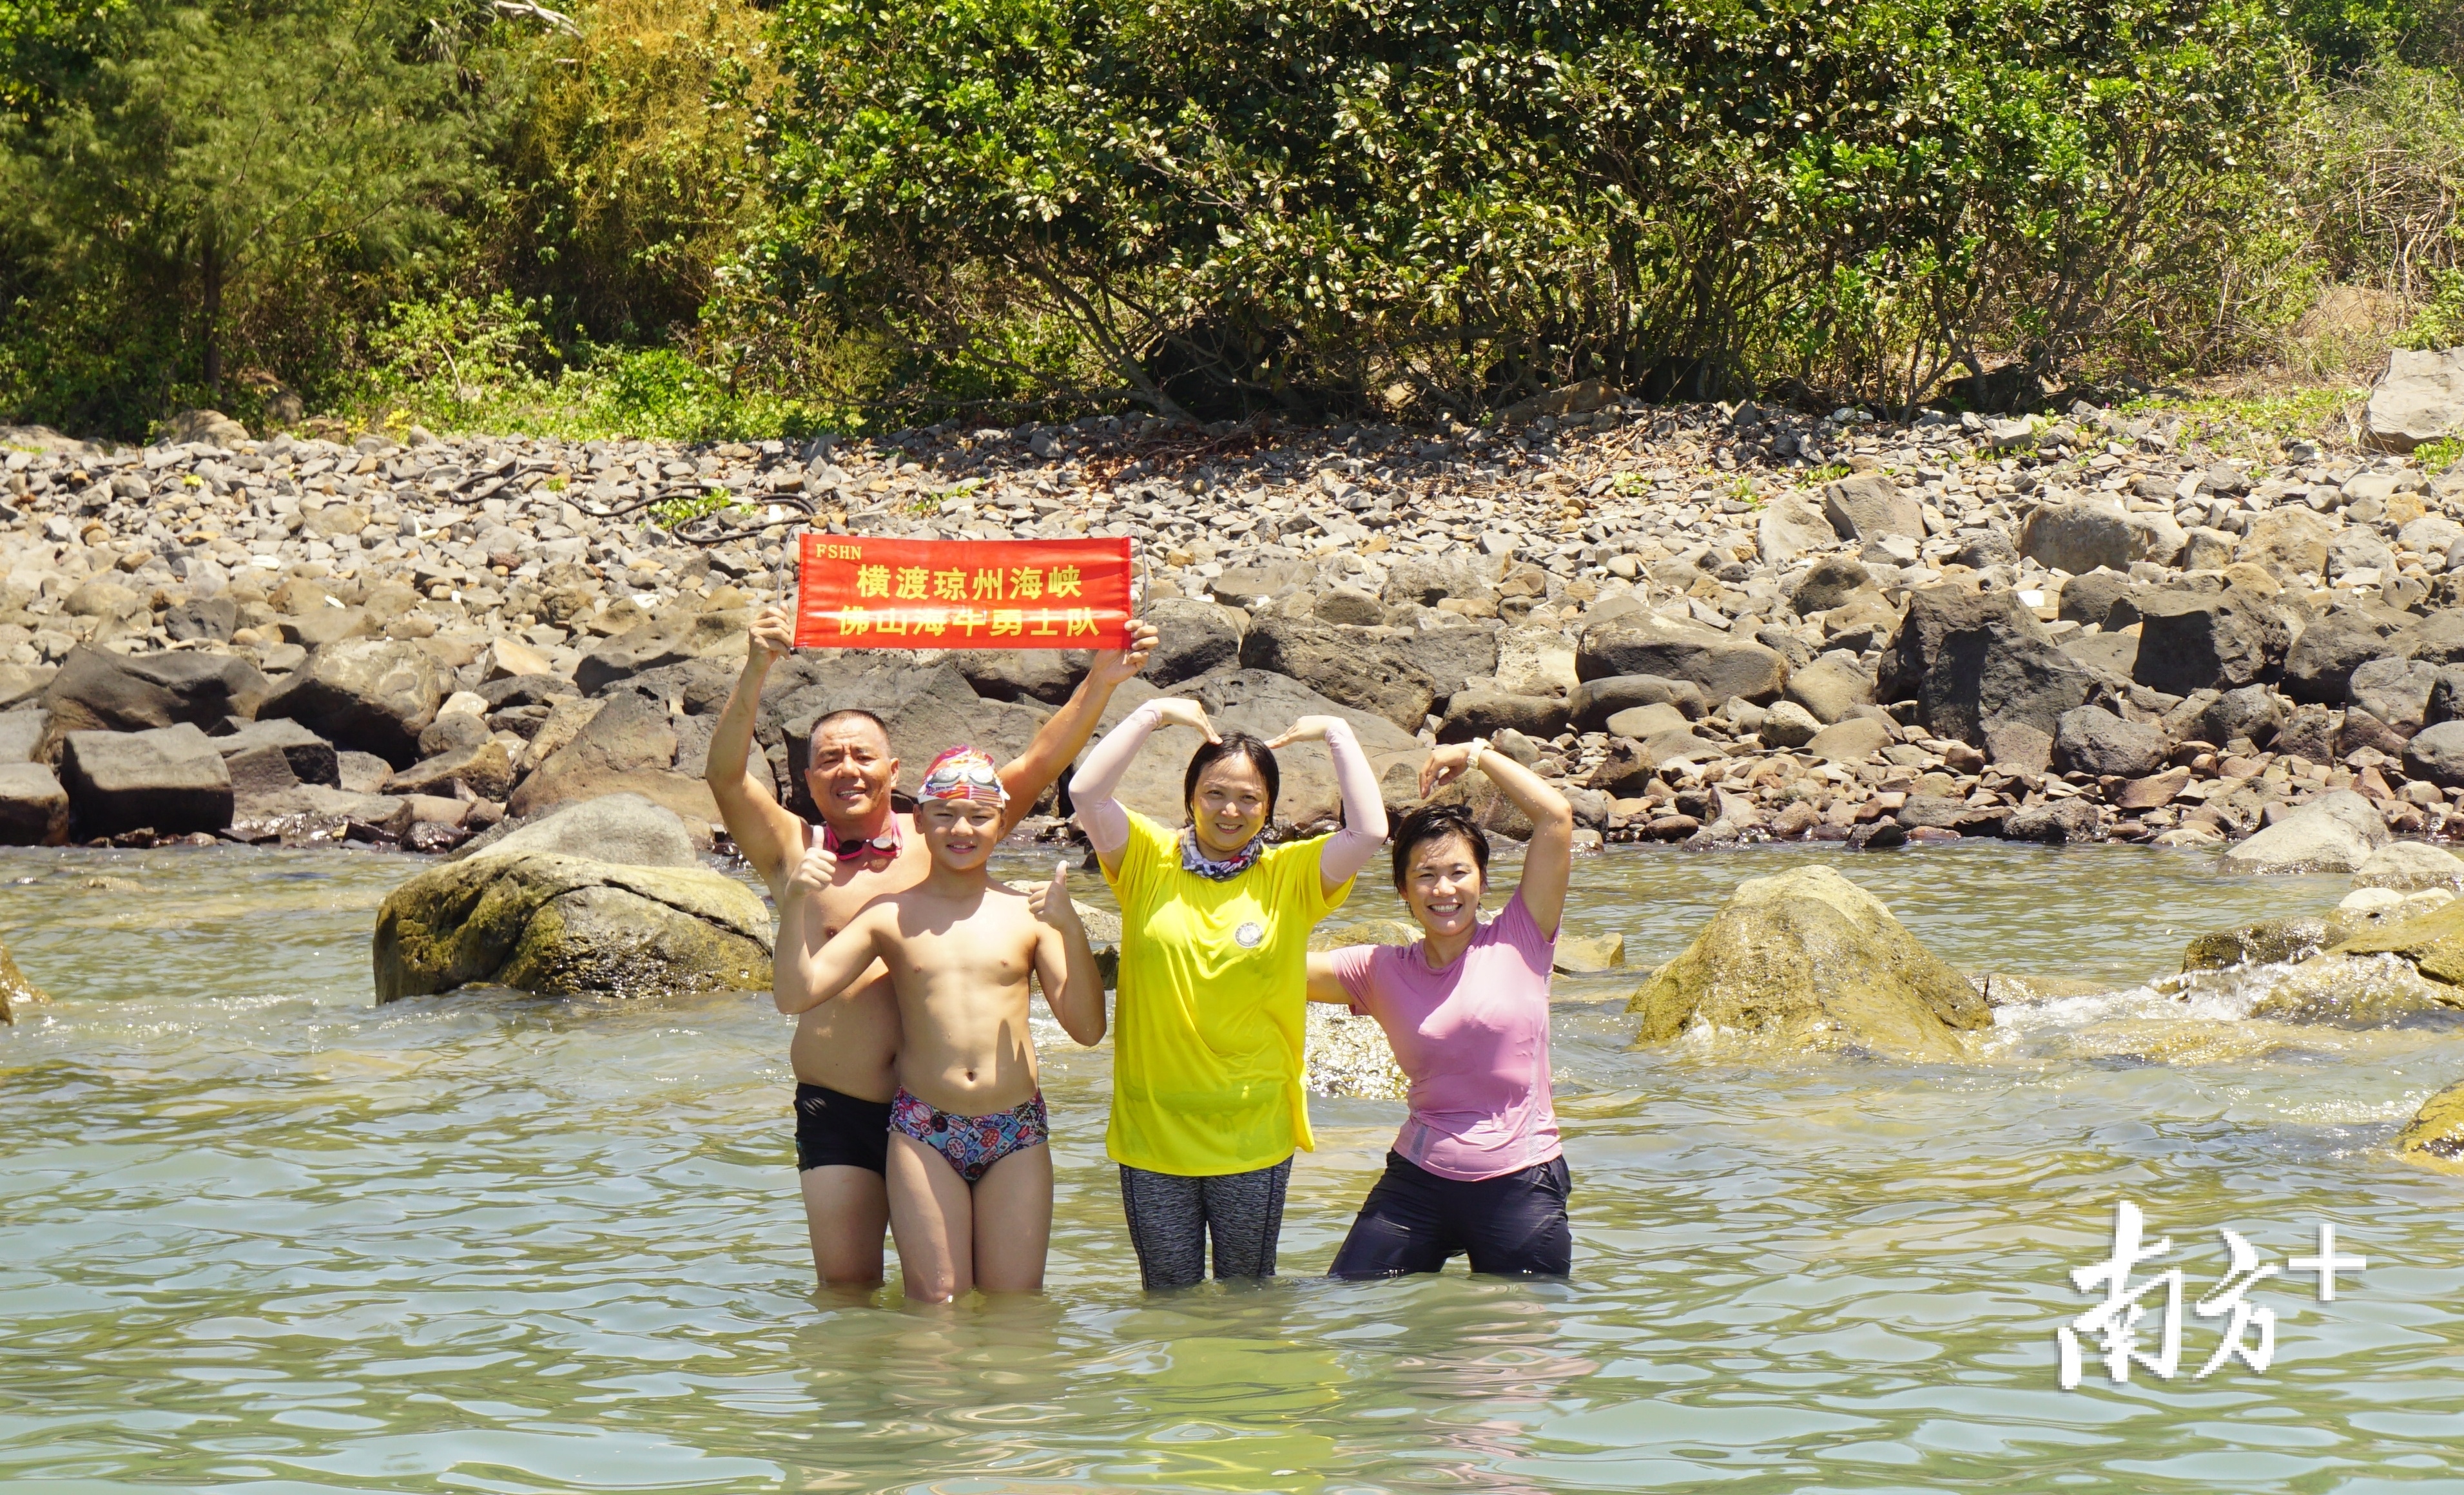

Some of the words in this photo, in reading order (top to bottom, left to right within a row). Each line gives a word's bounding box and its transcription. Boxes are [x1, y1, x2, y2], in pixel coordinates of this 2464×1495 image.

[816, 544, 862, 560] FSHN
[857, 564, 1083, 601] 横渡琼州海峡
[838, 605, 1100, 637] 佛山海牛勇士队
